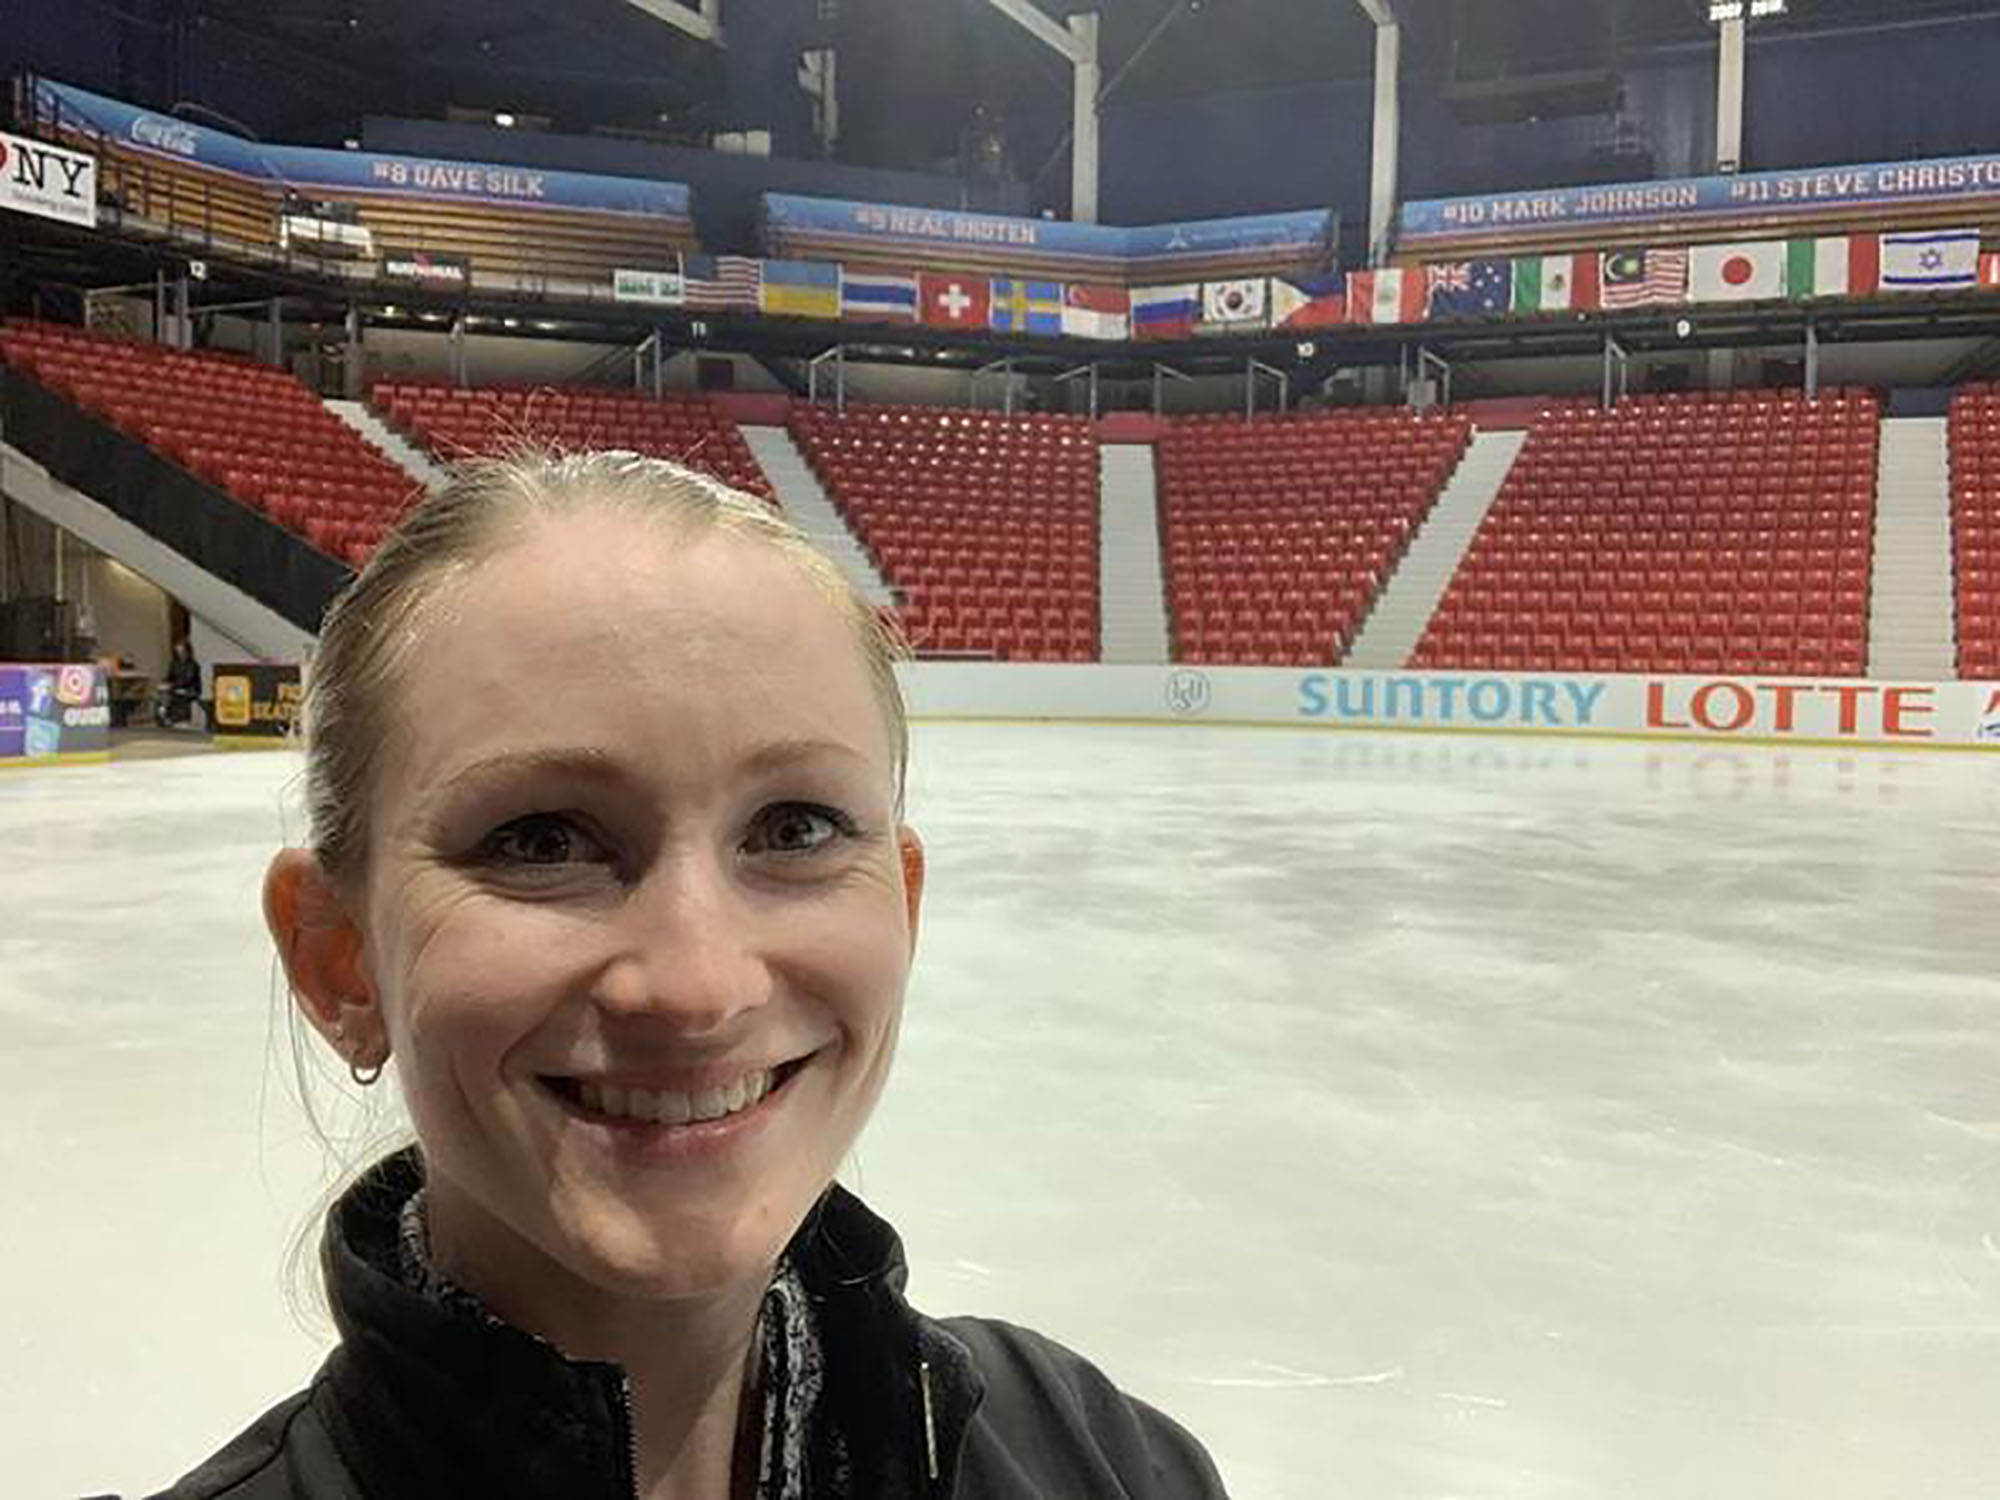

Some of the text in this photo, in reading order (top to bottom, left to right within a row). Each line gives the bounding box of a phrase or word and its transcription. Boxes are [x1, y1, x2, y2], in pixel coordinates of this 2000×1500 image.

[11, 142, 90, 199] NY
[412, 163, 483, 191] DAVE
[485, 172, 544, 197] SILK
[1777, 173, 1869, 199] STEVE
[1492, 196, 1566, 221] MARK
[1575, 184, 1697, 214] JOHNSON
[1299, 674, 1607, 725] SUNTORY
[1646, 681, 1935, 736] LOTTE
